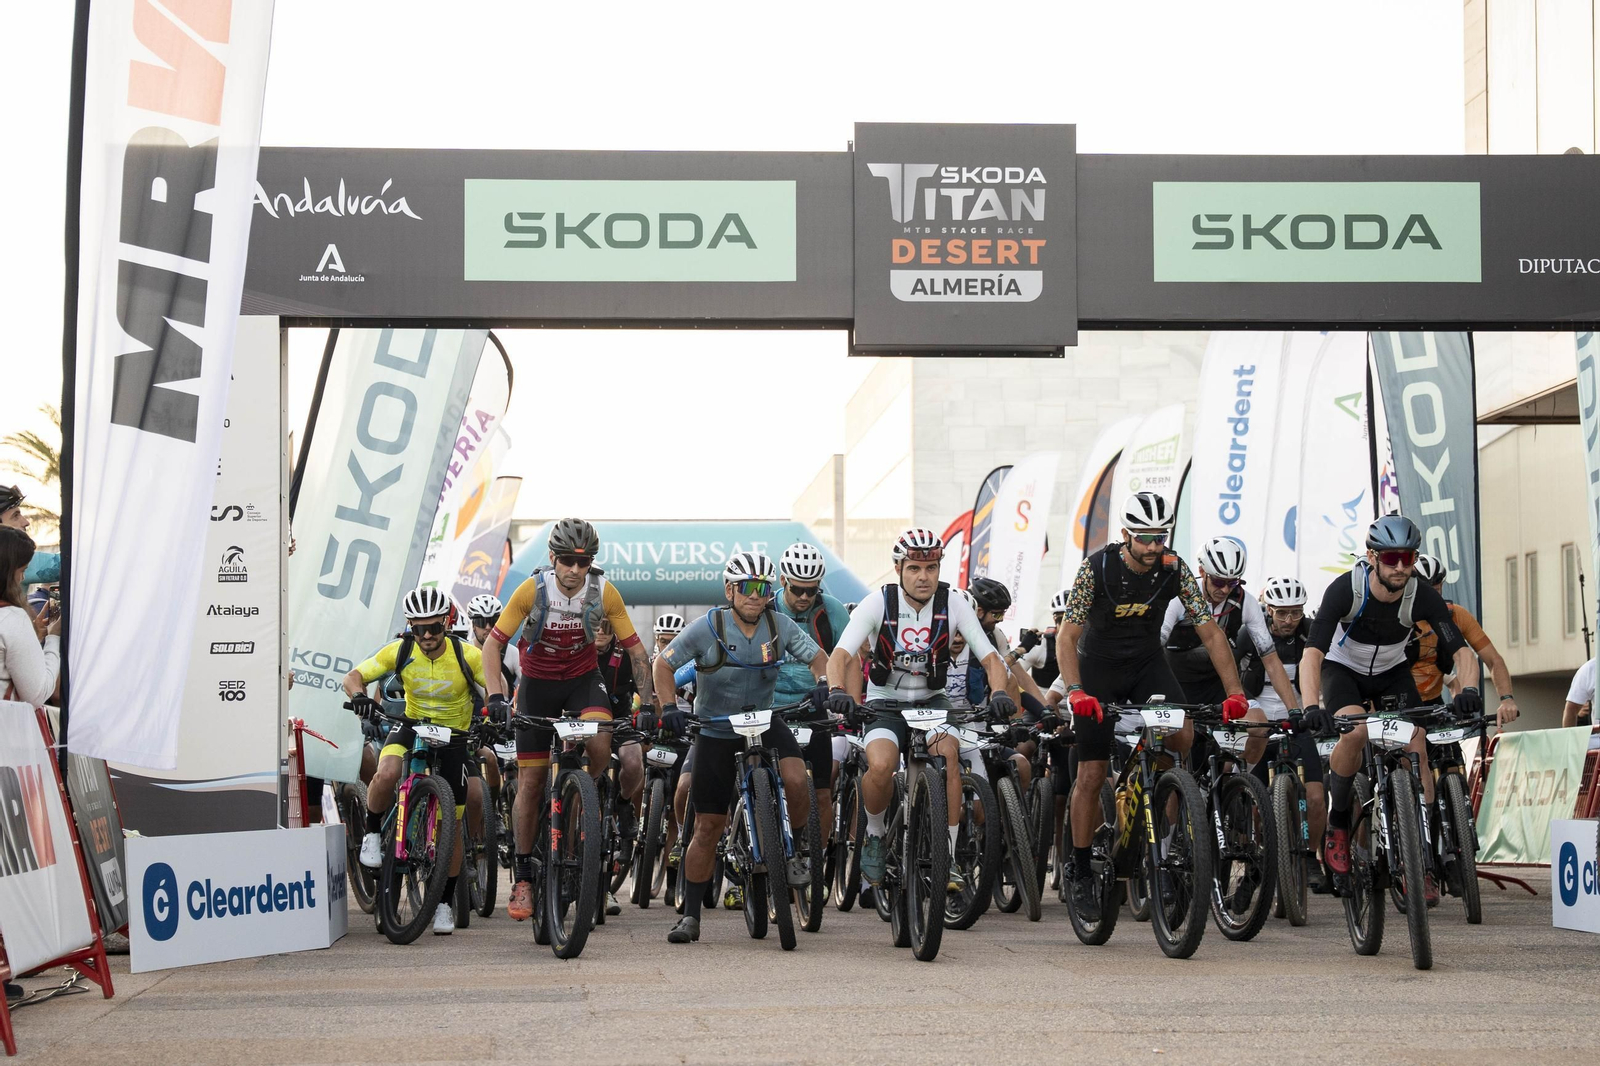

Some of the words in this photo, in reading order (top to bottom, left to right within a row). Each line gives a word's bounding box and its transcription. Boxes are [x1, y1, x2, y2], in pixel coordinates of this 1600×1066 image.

[941, 166, 1047, 184] SKODA
[253, 177, 424, 221] Andalucía
[867, 163, 1046, 223] TITAN
[504, 212, 757, 249] SKODA
[1191, 214, 1443, 250] SKODA
[891, 238, 1047, 265] DESERT
[1518, 258, 1600, 274] DIPUTAC
[298, 274, 319, 283] Junta
[320, 274, 330, 283] de
[330, 274, 365, 283] Andalucía
[910, 273, 1023, 296] ALMERÍA
[1218, 365, 1256, 526] Cleardent
[655, 568, 721, 584] Superior
[219, 680, 246, 689] SER
[218, 690, 246, 702] 100
[744, 712, 757, 720] 51
[1154, 710, 1171, 718] 96
[1382, 720, 1398, 732] 94
[1223, 732, 1236, 742] 93
[656, 750, 667, 759] 81
[187, 870, 316, 921] Cleardent
